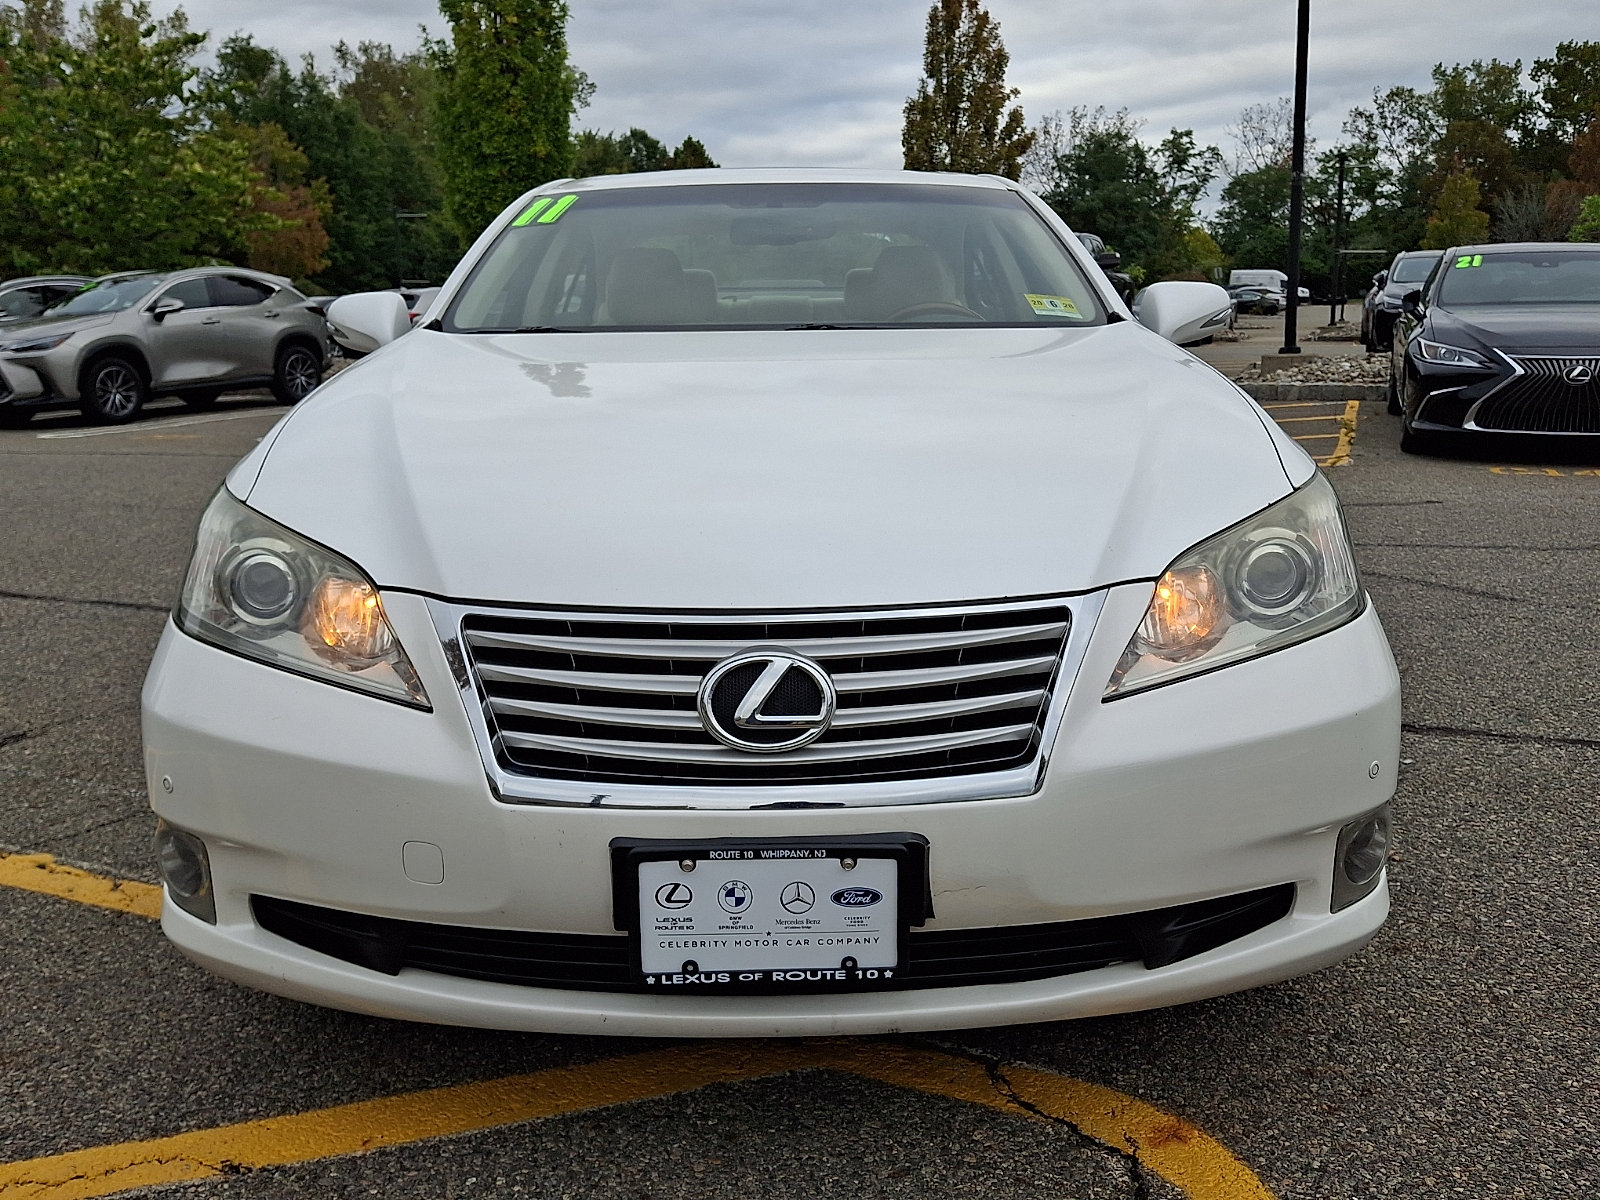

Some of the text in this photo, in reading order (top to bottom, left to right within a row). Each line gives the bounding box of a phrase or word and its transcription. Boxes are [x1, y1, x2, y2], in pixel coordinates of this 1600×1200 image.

[511, 195, 580, 227] 11
[1455, 254, 1483, 268] 21
[709, 850, 741, 859] ROUTE
[743, 850, 754, 859] 10
[814, 849, 826, 858] NJ
[840, 890, 873, 904] Ford
[659, 936, 880, 949] CELEBRITY MOTOR CAR COMPANY
[661, 969, 879, 985] LEXUS OF ROUTE 10
